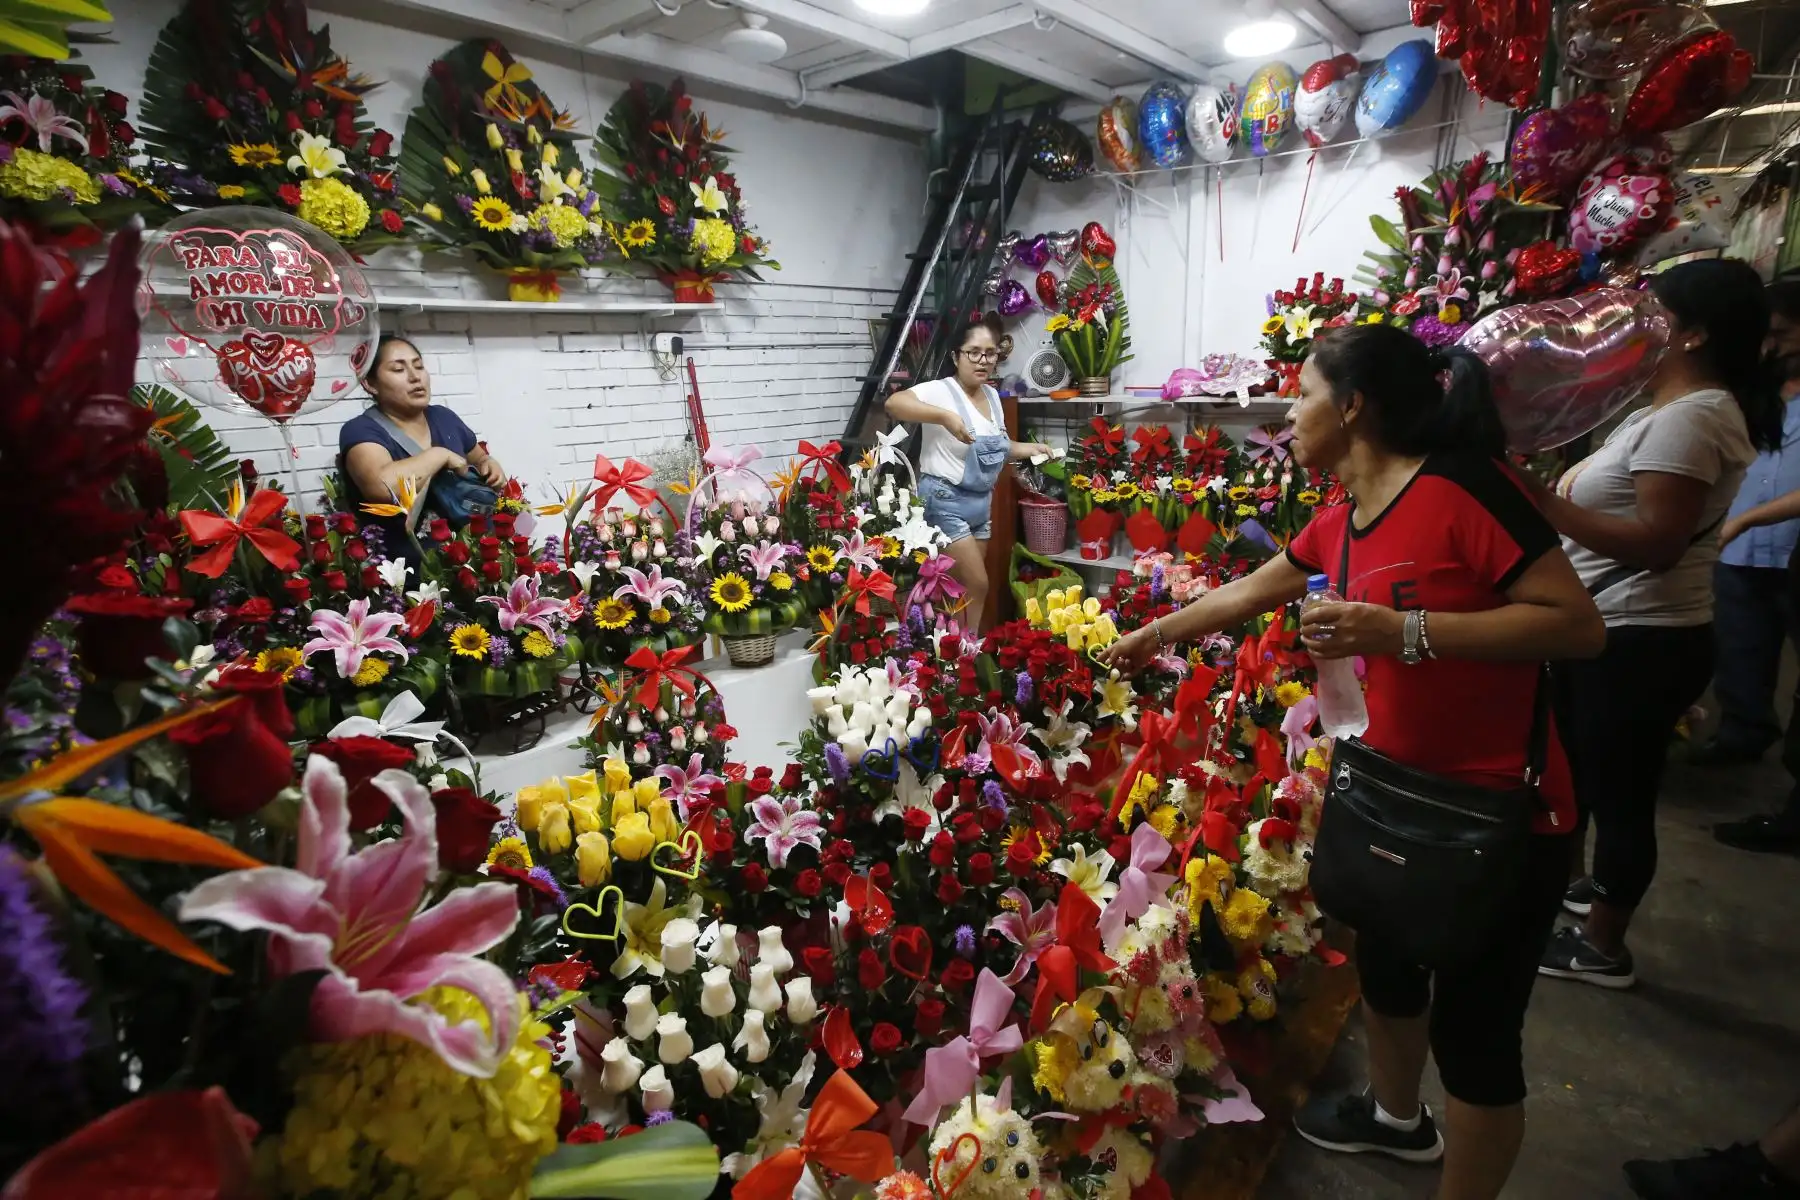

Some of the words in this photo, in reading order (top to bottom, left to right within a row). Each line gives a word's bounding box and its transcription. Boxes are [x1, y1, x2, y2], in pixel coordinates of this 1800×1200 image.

[1593, 185, 1606, 201] Te
[1603, 194, 1633, 219] Quiero
[1586, 204, 1616, 229] Mucho
[182, 246, 260, 270] PARA
[272, 249, 311, 273] EL
[189, 271, 270, 301] AMOR
[280, 274, 316, 299] DE
[208, 301, 247, 326] MI
[253, 301, 326, 329] VIDA
